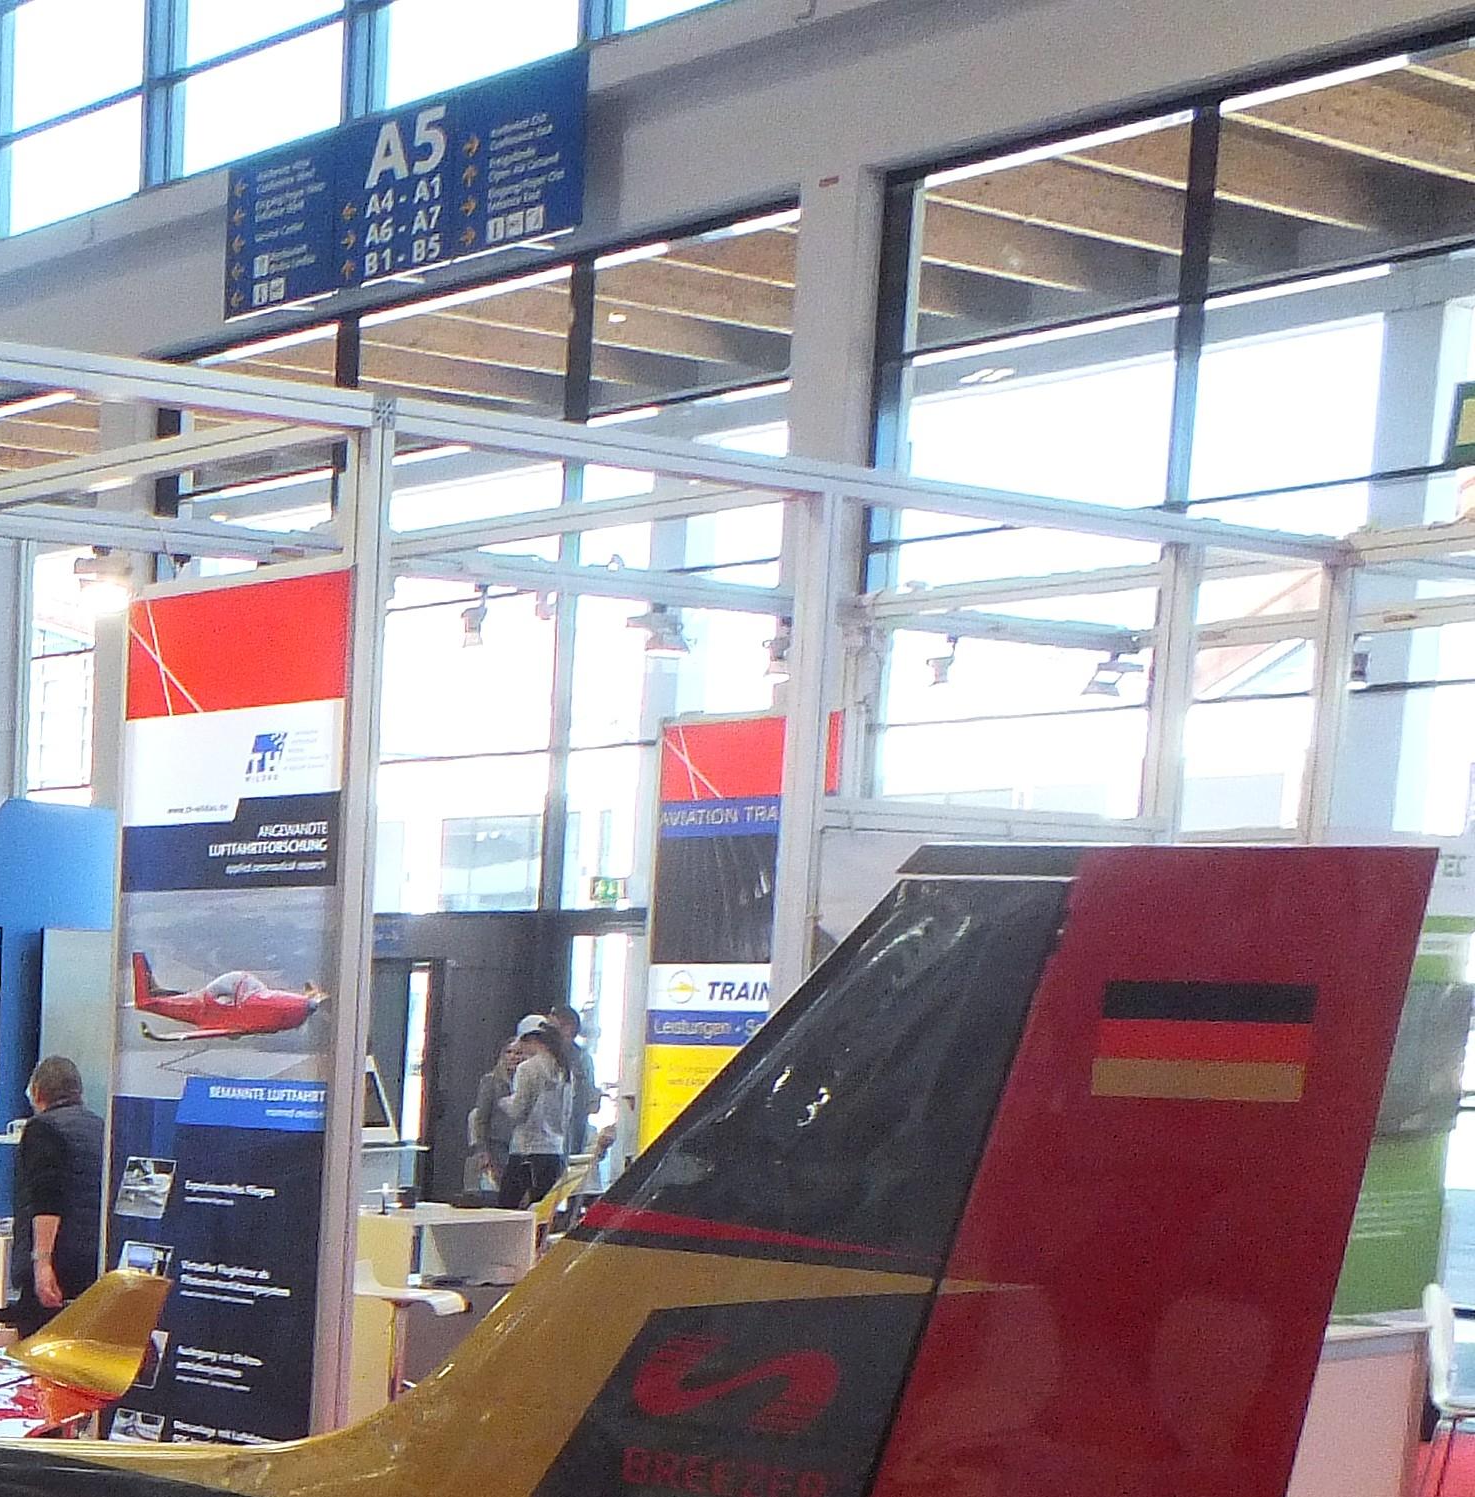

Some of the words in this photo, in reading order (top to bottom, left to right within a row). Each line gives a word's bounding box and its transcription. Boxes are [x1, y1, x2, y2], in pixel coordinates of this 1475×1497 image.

[364, 104, 447, 190] A5
[365, 189, 395, 218] A4
[414, 174, 442, 203] A1
[365, 221, 393, 248] A6
[412, 205, 440, 235] A7
[365, 249, 392, 276] B1
[412, 233, 442, 263] B5
[661, 807, 739, 826] AVIATION
[654, 1018, 732, 1039] Leistungen
[209, 1086, 264, 1100] BEMANNTE
[267, 1088, 325, 1102] LUFTFAHRT
